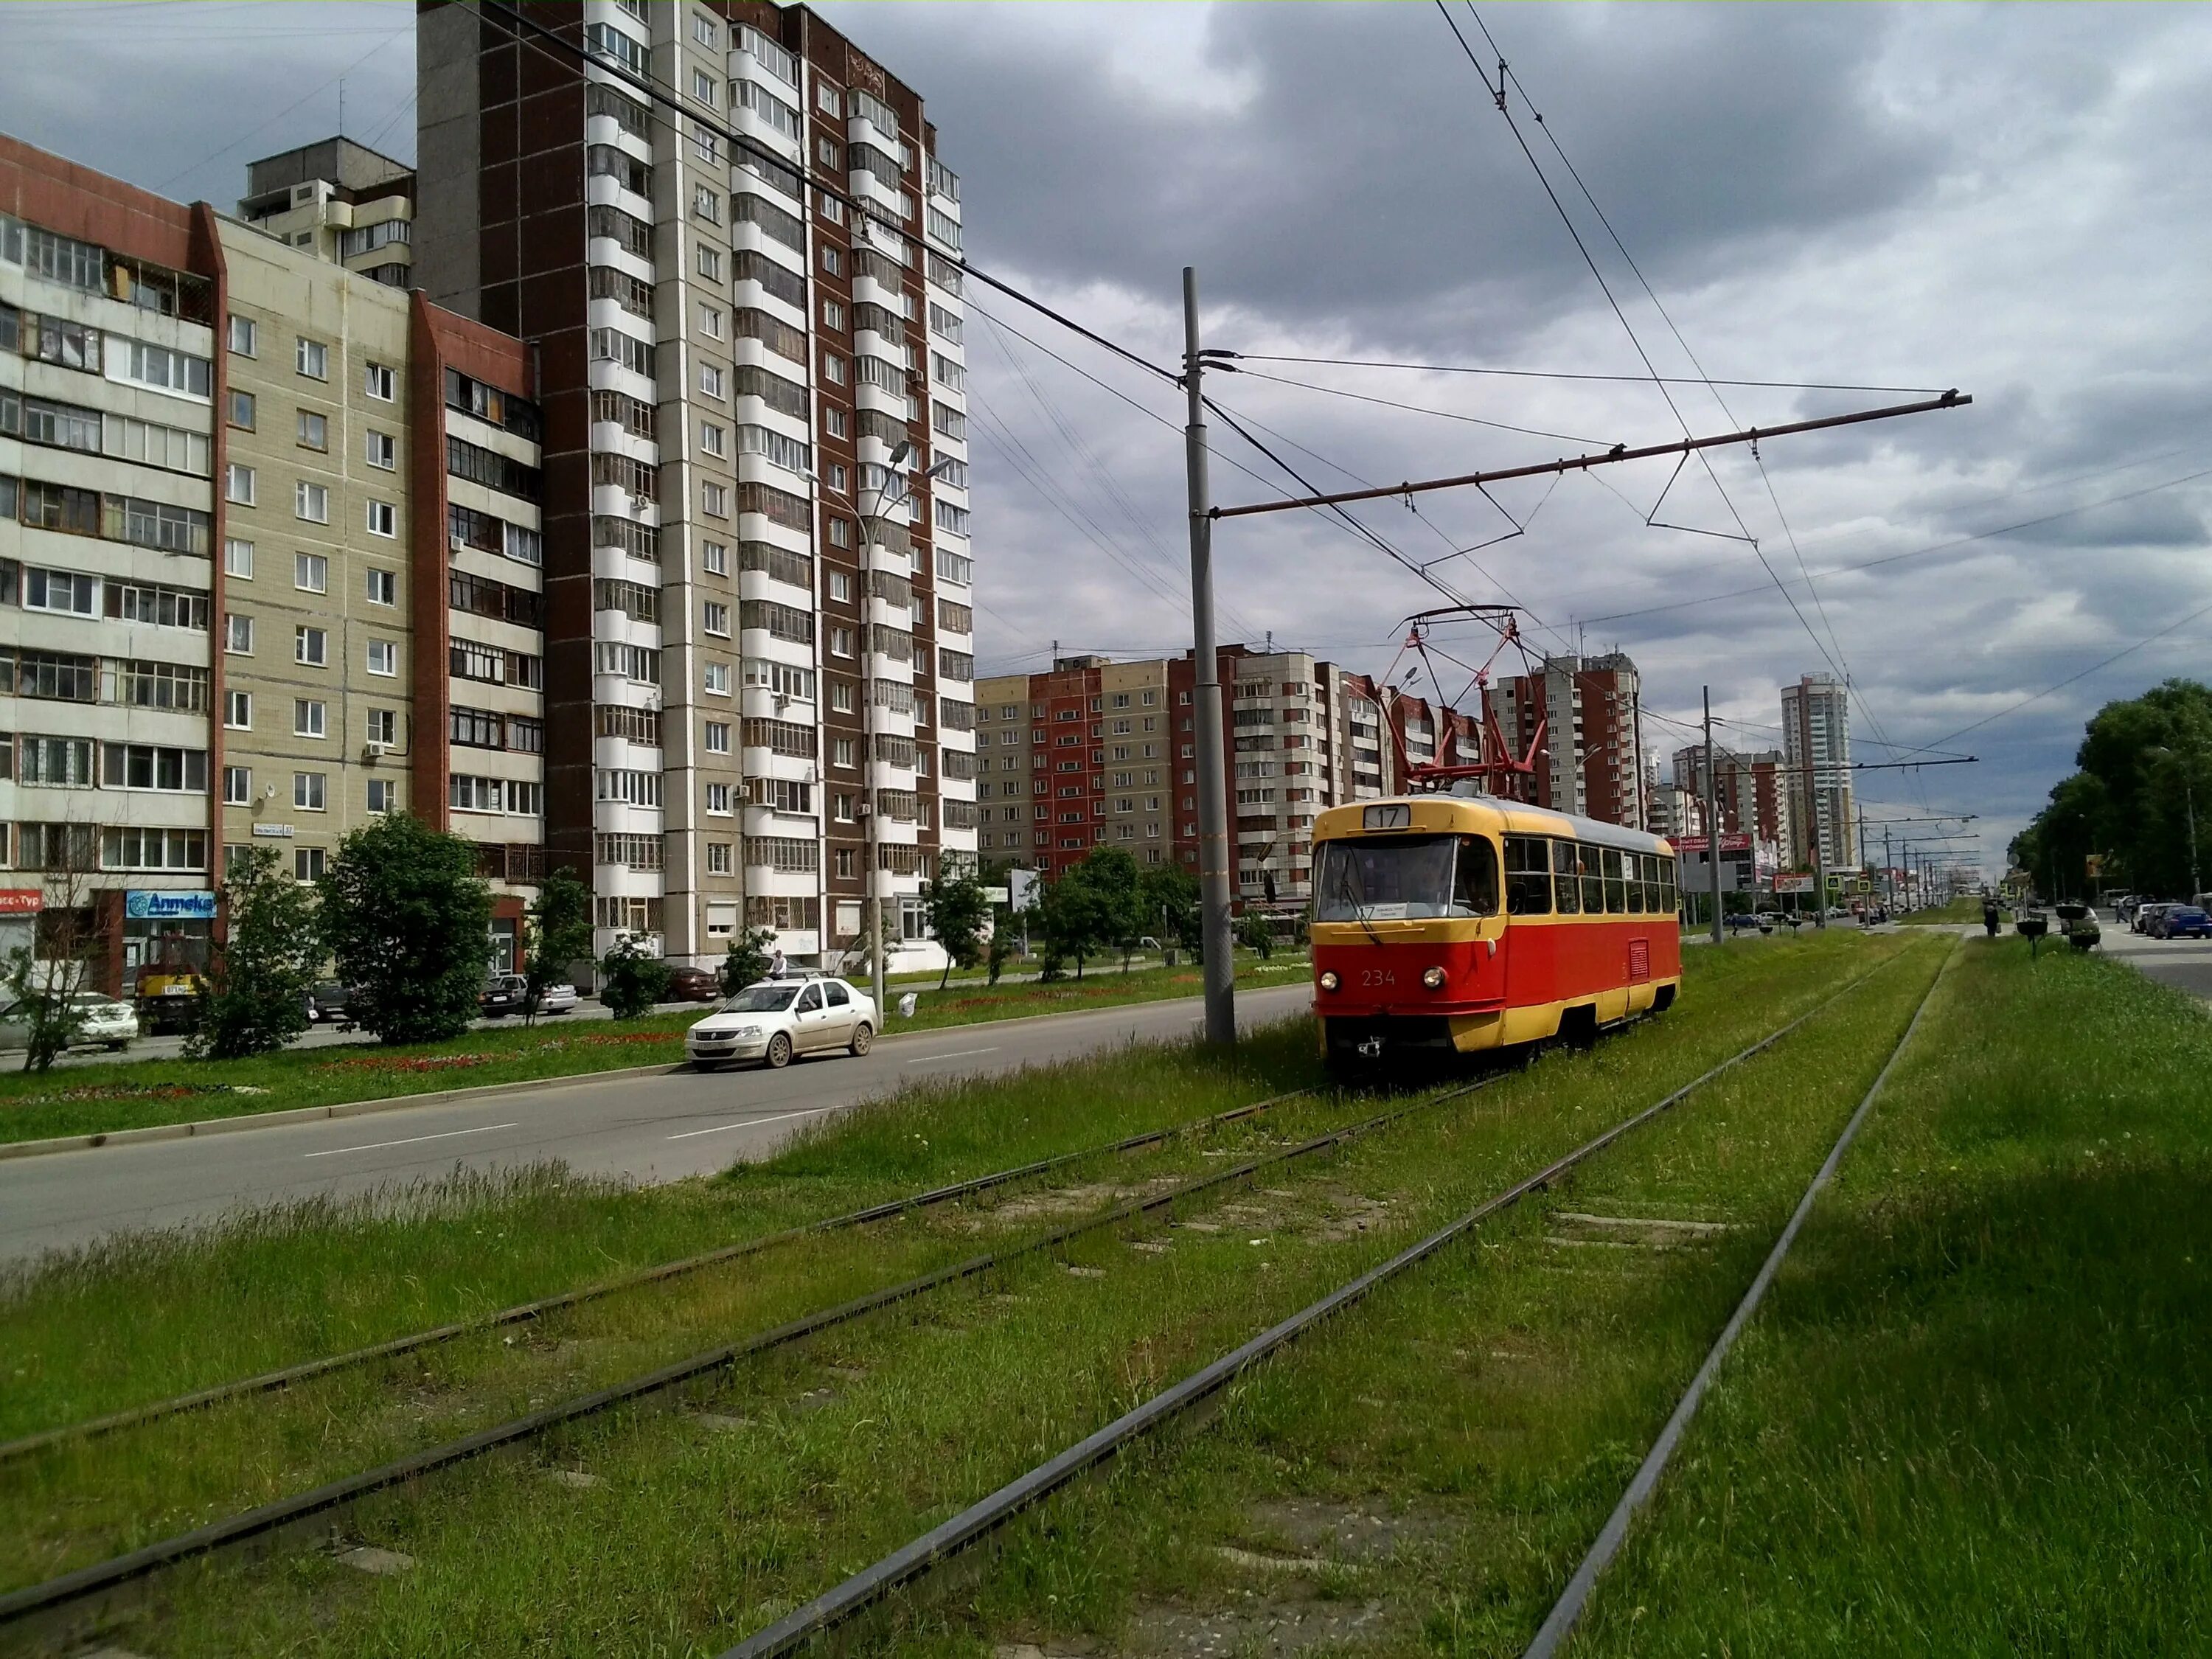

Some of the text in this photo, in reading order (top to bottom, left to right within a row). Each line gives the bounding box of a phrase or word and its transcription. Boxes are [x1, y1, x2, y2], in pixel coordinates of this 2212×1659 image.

[1378, 808, 1399, 827] 17
[147, 893, 214, 912] Аптека
[1362, 970, 1395, 986] 234
